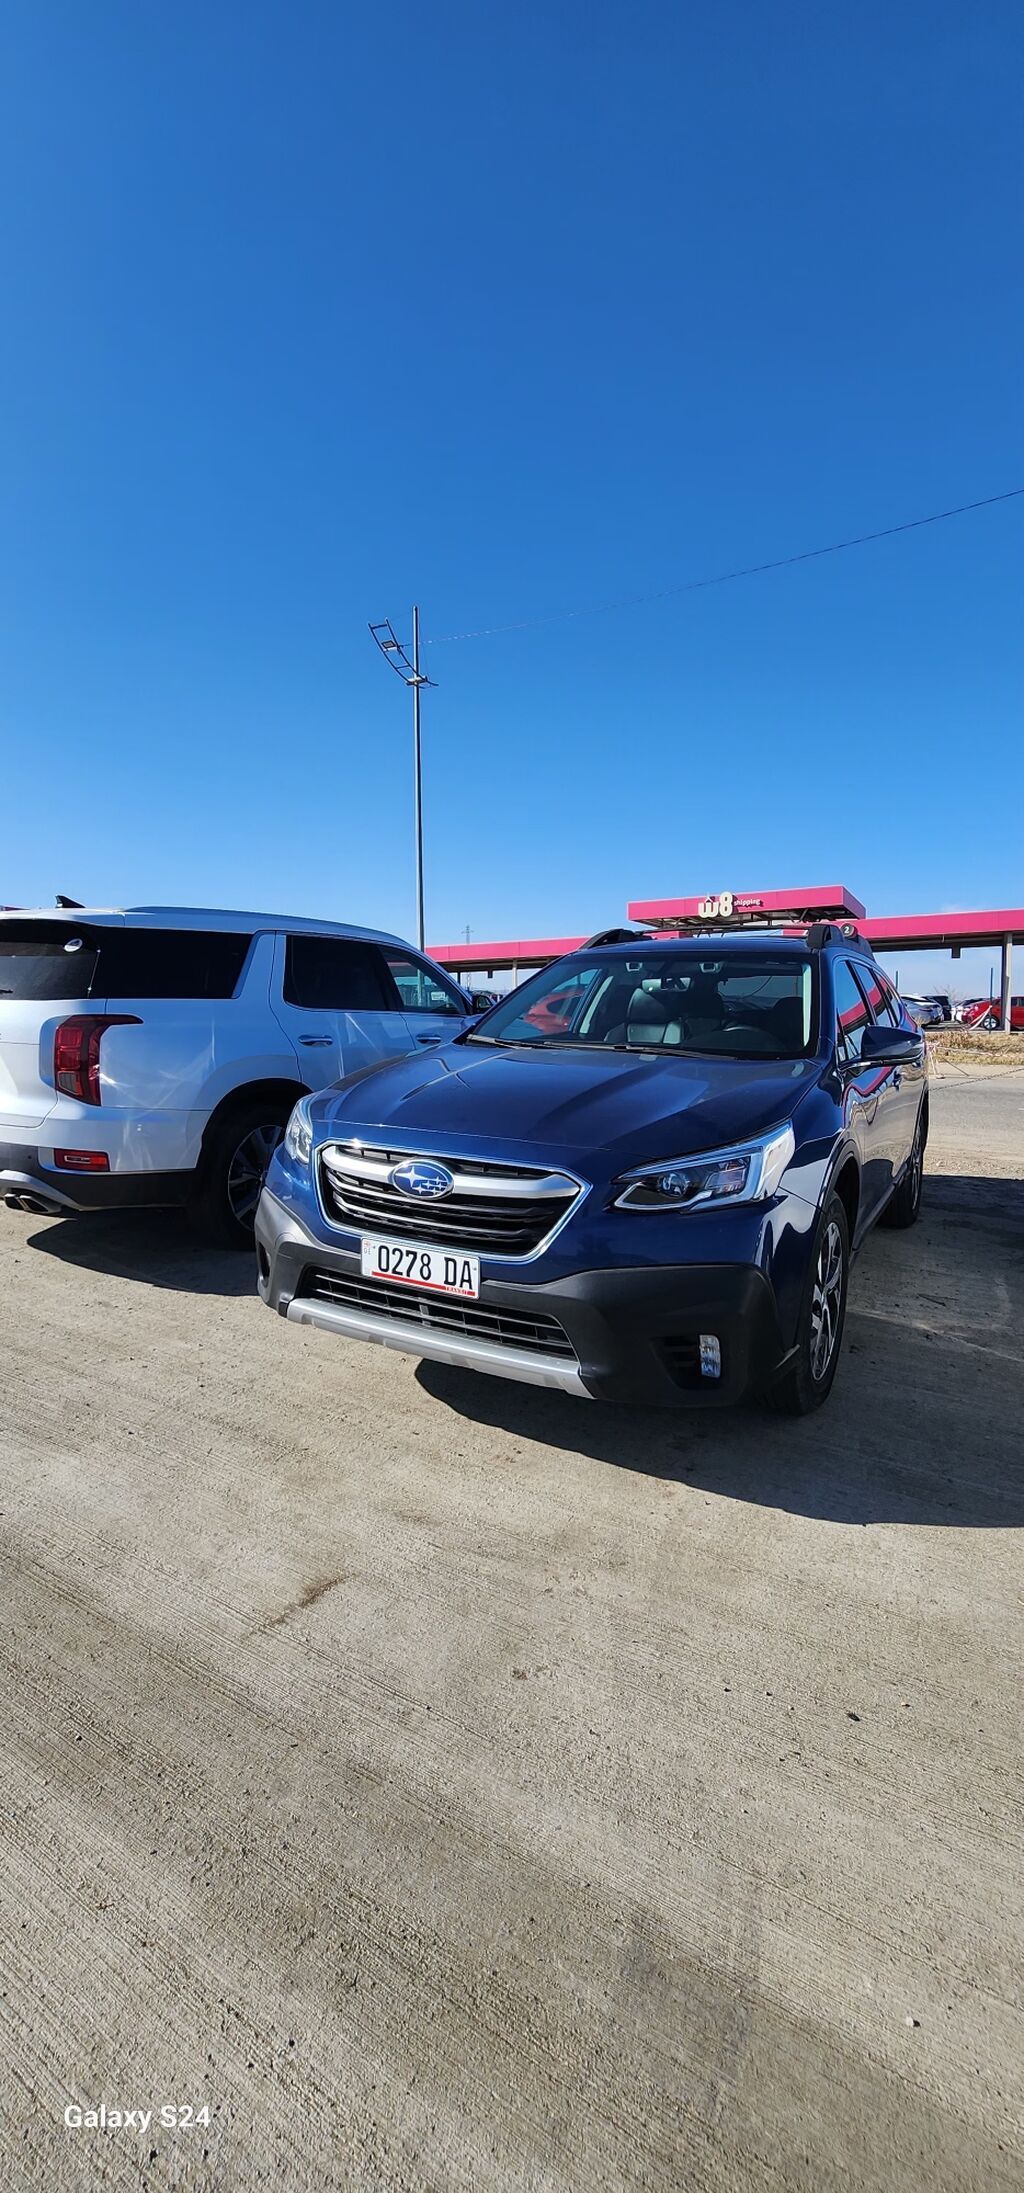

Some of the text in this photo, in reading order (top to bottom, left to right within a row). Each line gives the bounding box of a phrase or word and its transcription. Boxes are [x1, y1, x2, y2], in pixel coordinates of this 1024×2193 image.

[734, 898, 761, 907] shipping
[378, 1245, 472, 1290] 0278 DA
